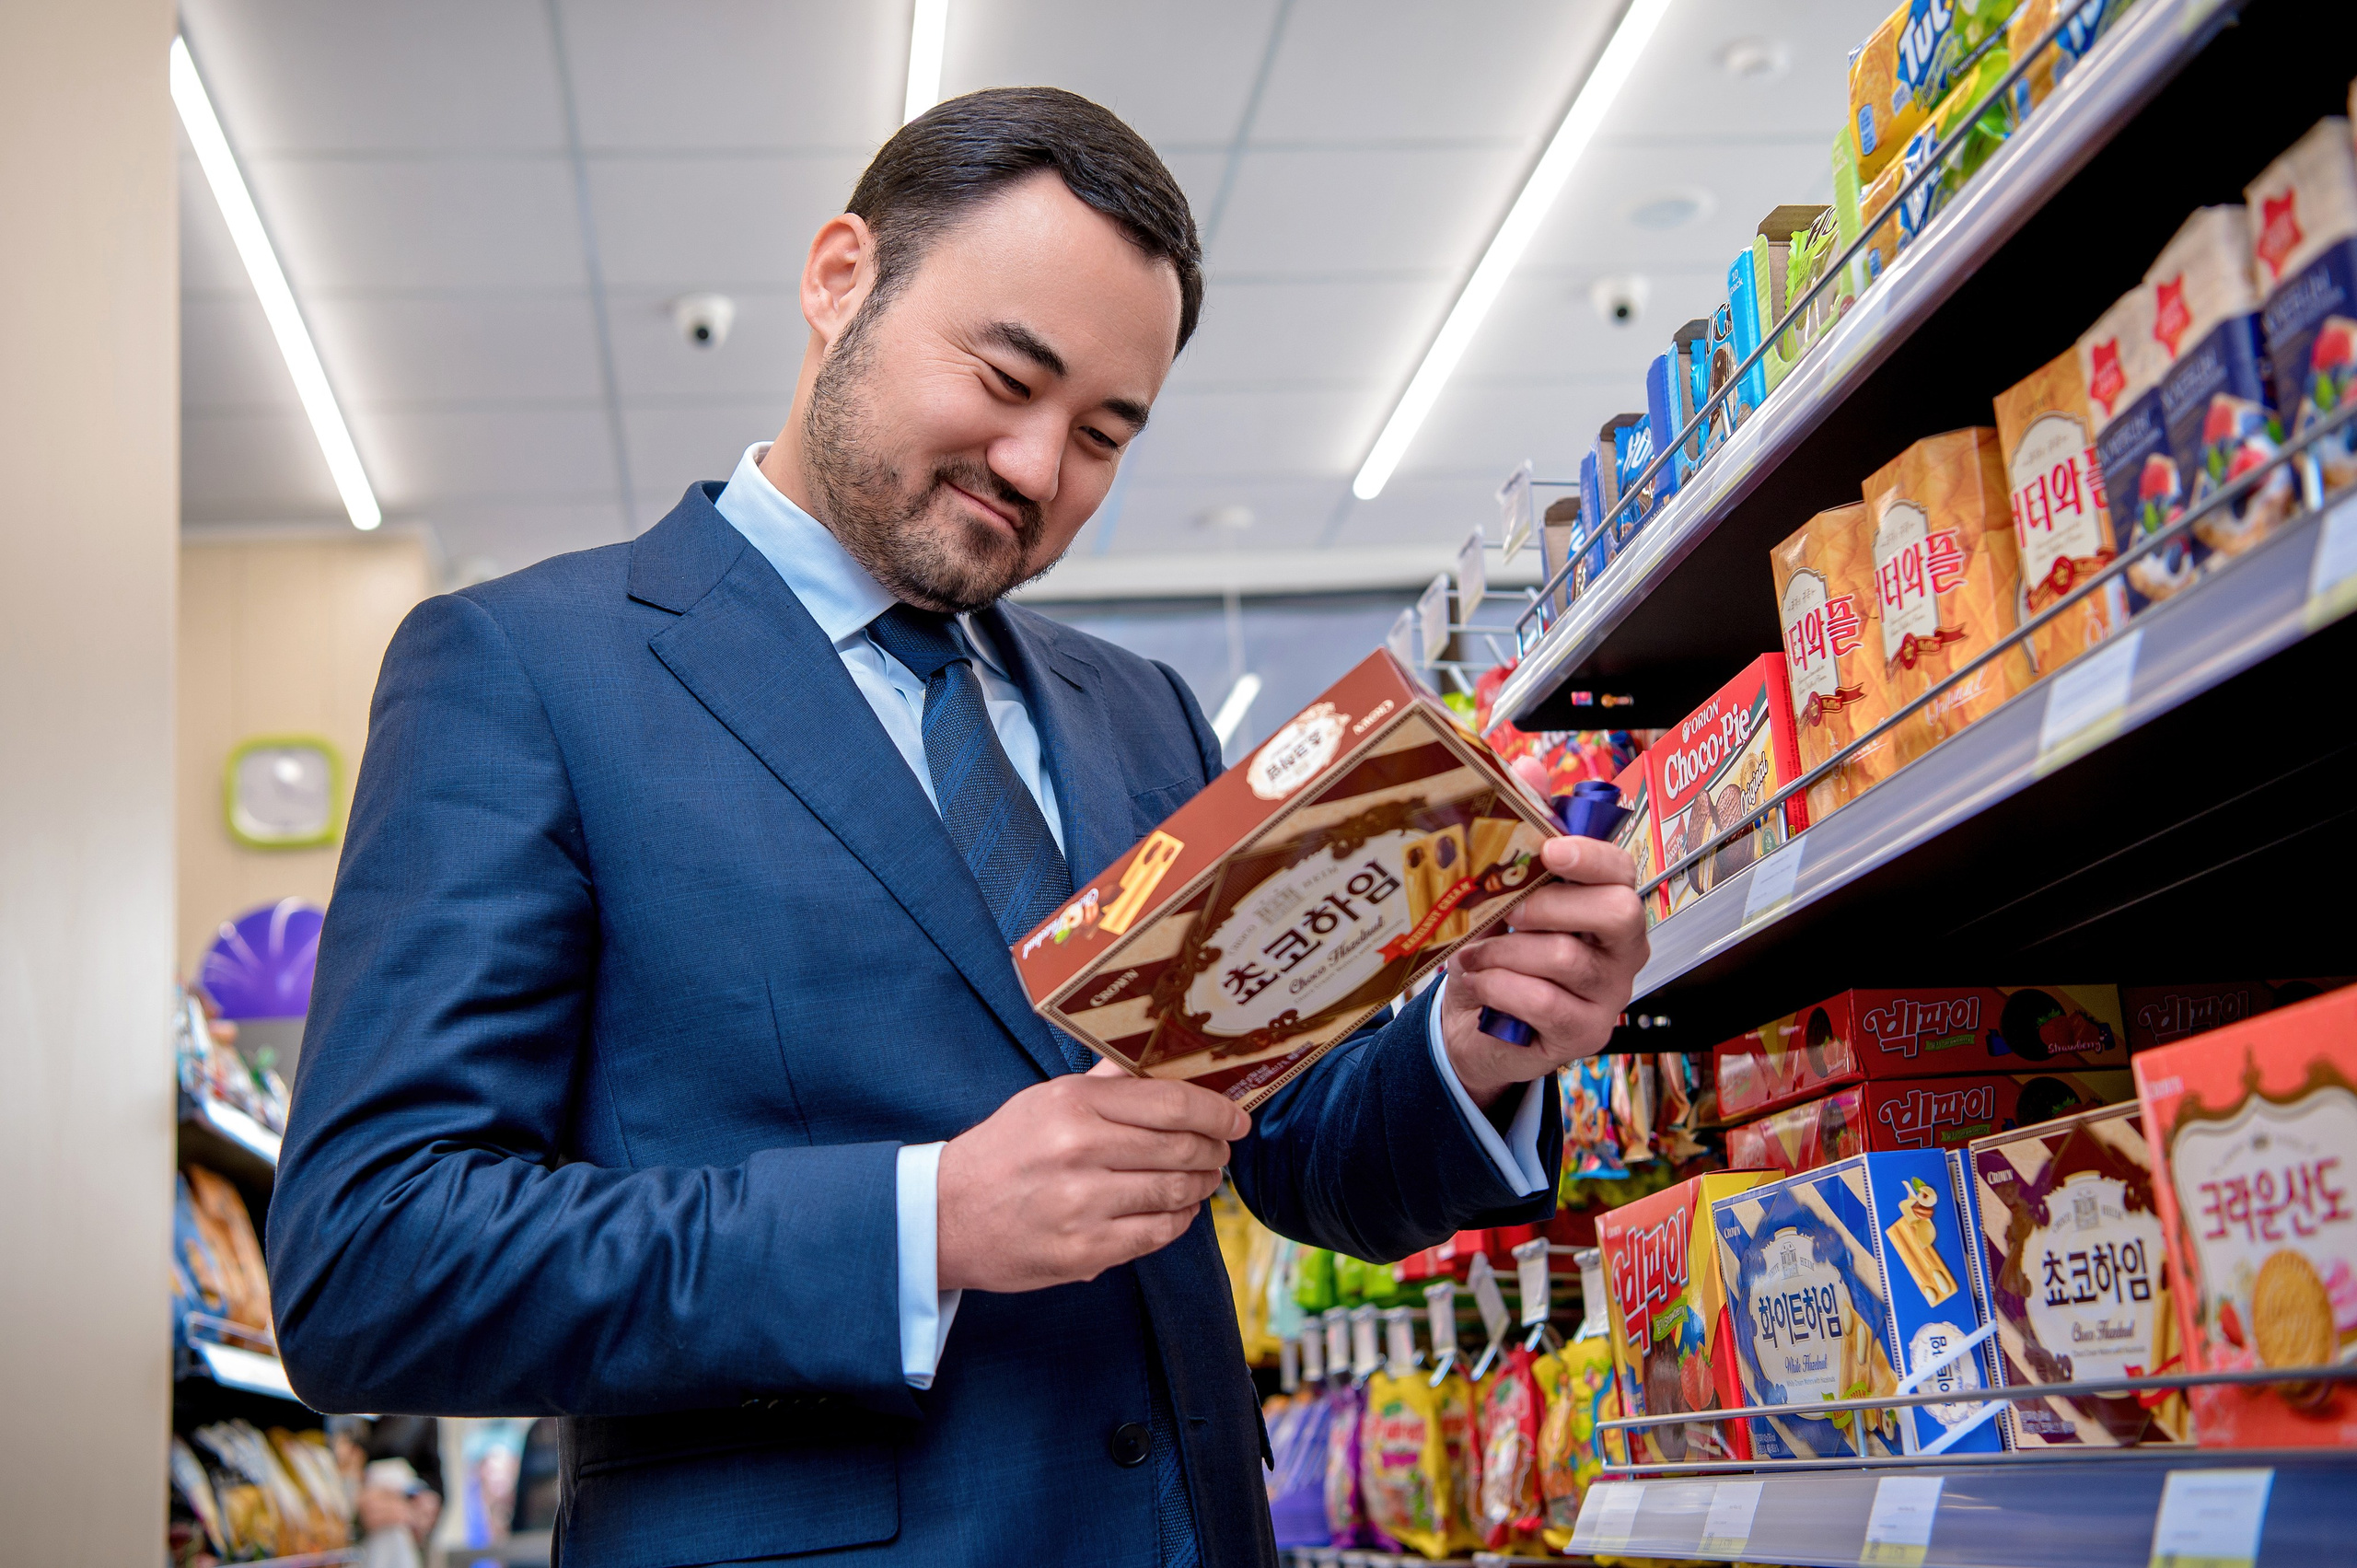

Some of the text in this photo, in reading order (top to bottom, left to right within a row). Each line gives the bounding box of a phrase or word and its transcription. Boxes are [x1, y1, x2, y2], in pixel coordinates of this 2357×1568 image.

[1730, 277, 1744, 296] pack
[1732, 269, 1739, 282] 10
[1691, 701, 1719, 734] ORION
[1740, 751, 1769, 817] Original
[1289, 965, 1327, 994] Choco
[1327, 914, 1386, 967] Hazelnut
[1090, 969, 1139, 1006] CROWN
[1864, 996, 1980, 1058] 빅파이
[2048, 1040, 2102, 1054] Strawberry
[1878, 1086, 1995, 1149] 빅파이
[1987, 1168, 2014, 1185] CROWN
[2199, 1156, 2352, 1243] 크라운산도
[1724, 1225, 1740, 1239] CROWN
[1611, 1205, 1689, 1358] 빅파이
[2043, 1237, 2153, 1307] 쵸코하임
[1759, 1283, 1842, 1348] 화이트하임
[1785, 1353, 1828, 1375] White Hazelnut
